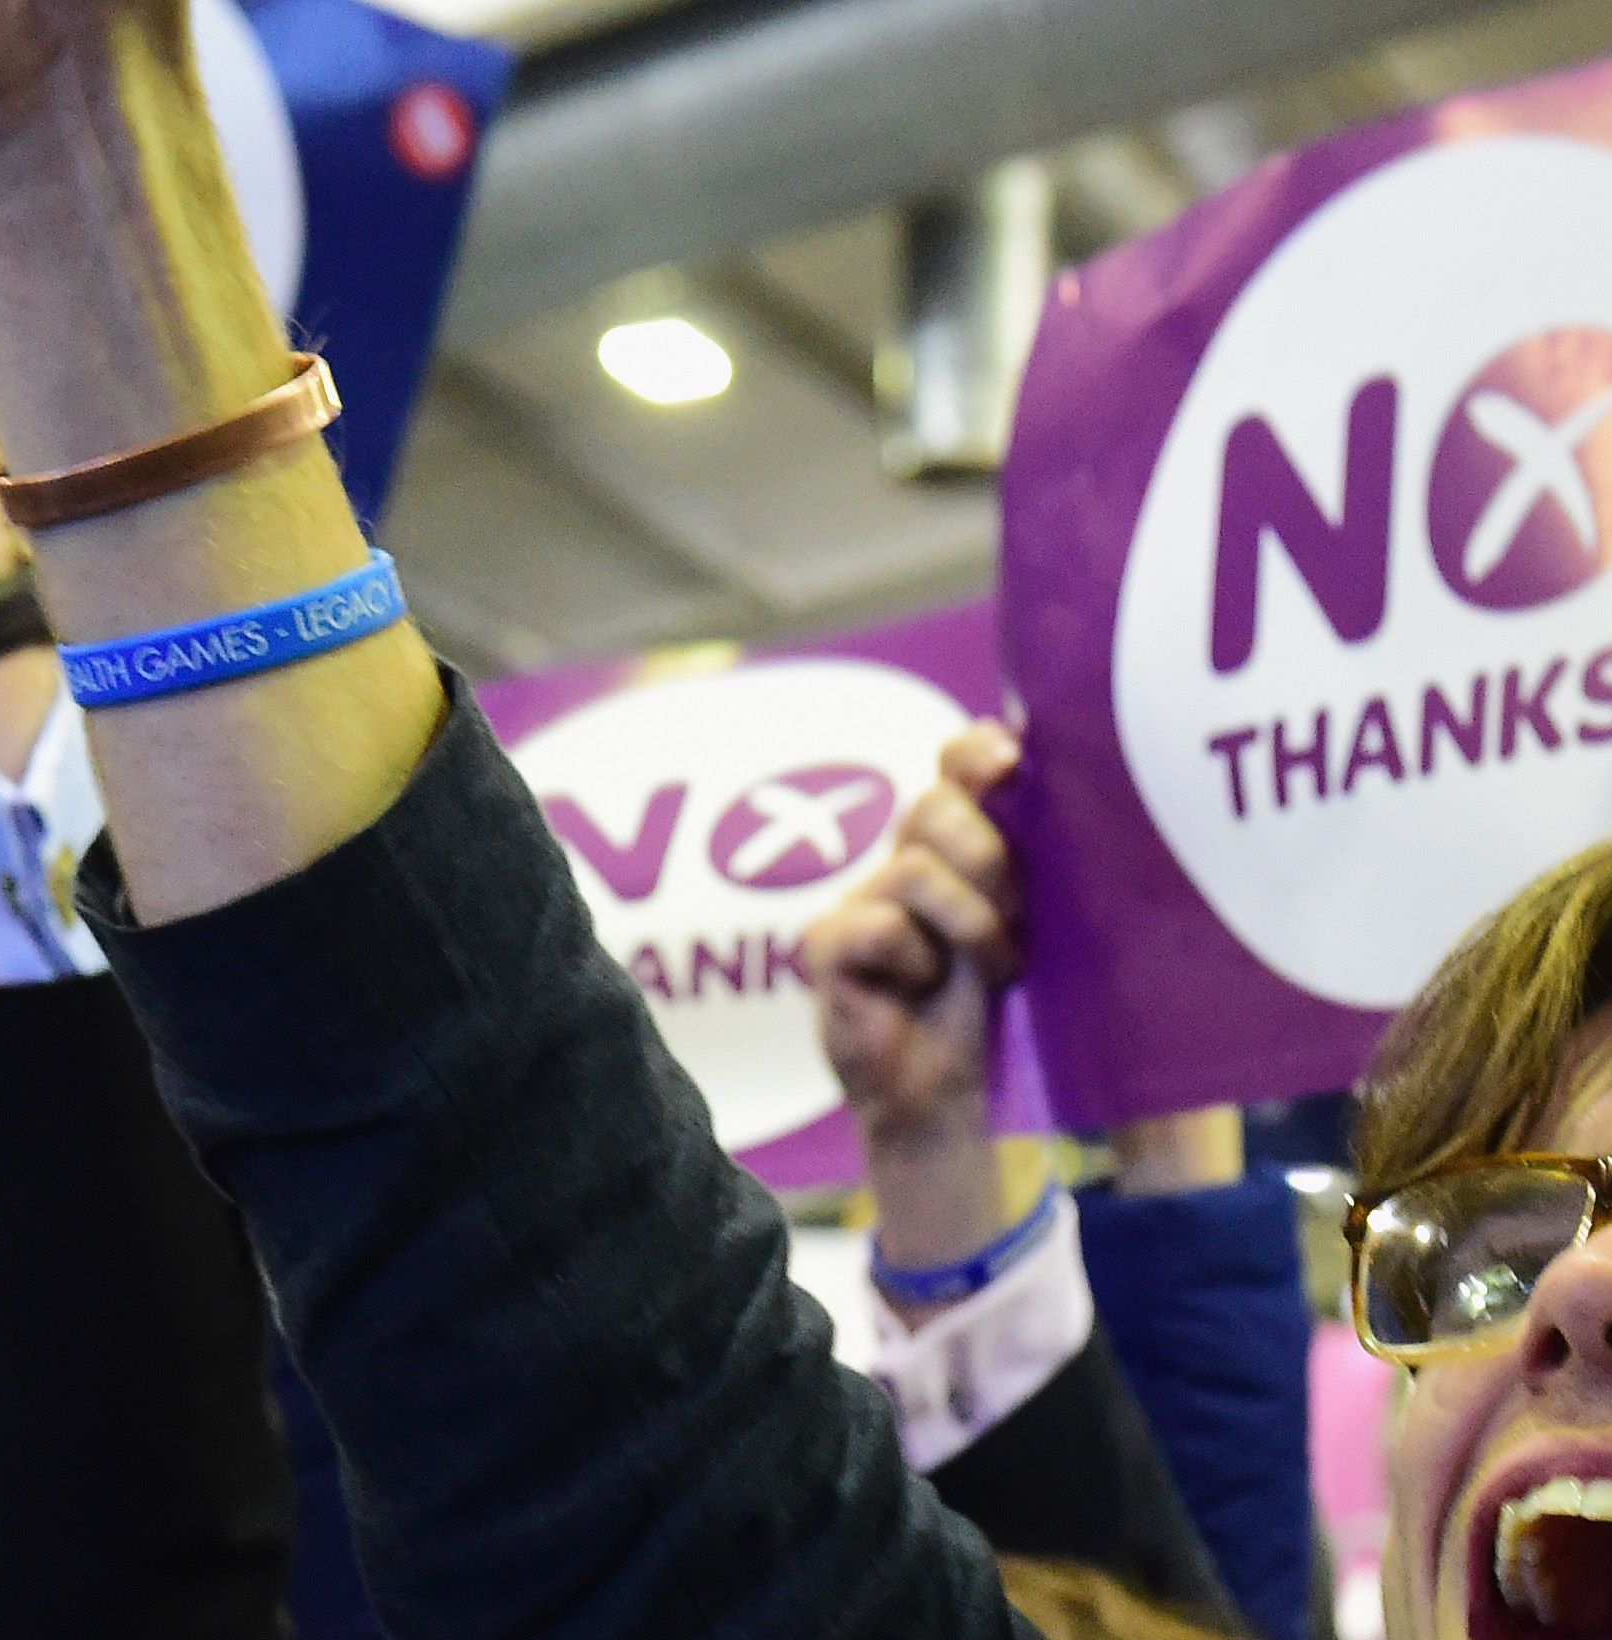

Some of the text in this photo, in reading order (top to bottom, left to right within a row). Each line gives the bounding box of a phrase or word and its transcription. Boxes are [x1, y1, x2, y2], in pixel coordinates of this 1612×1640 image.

[134, 620, 269, 682] GAMES
[291, 579, 392, 641] LEGAC
[630, 930, 820, 1002] ANK
